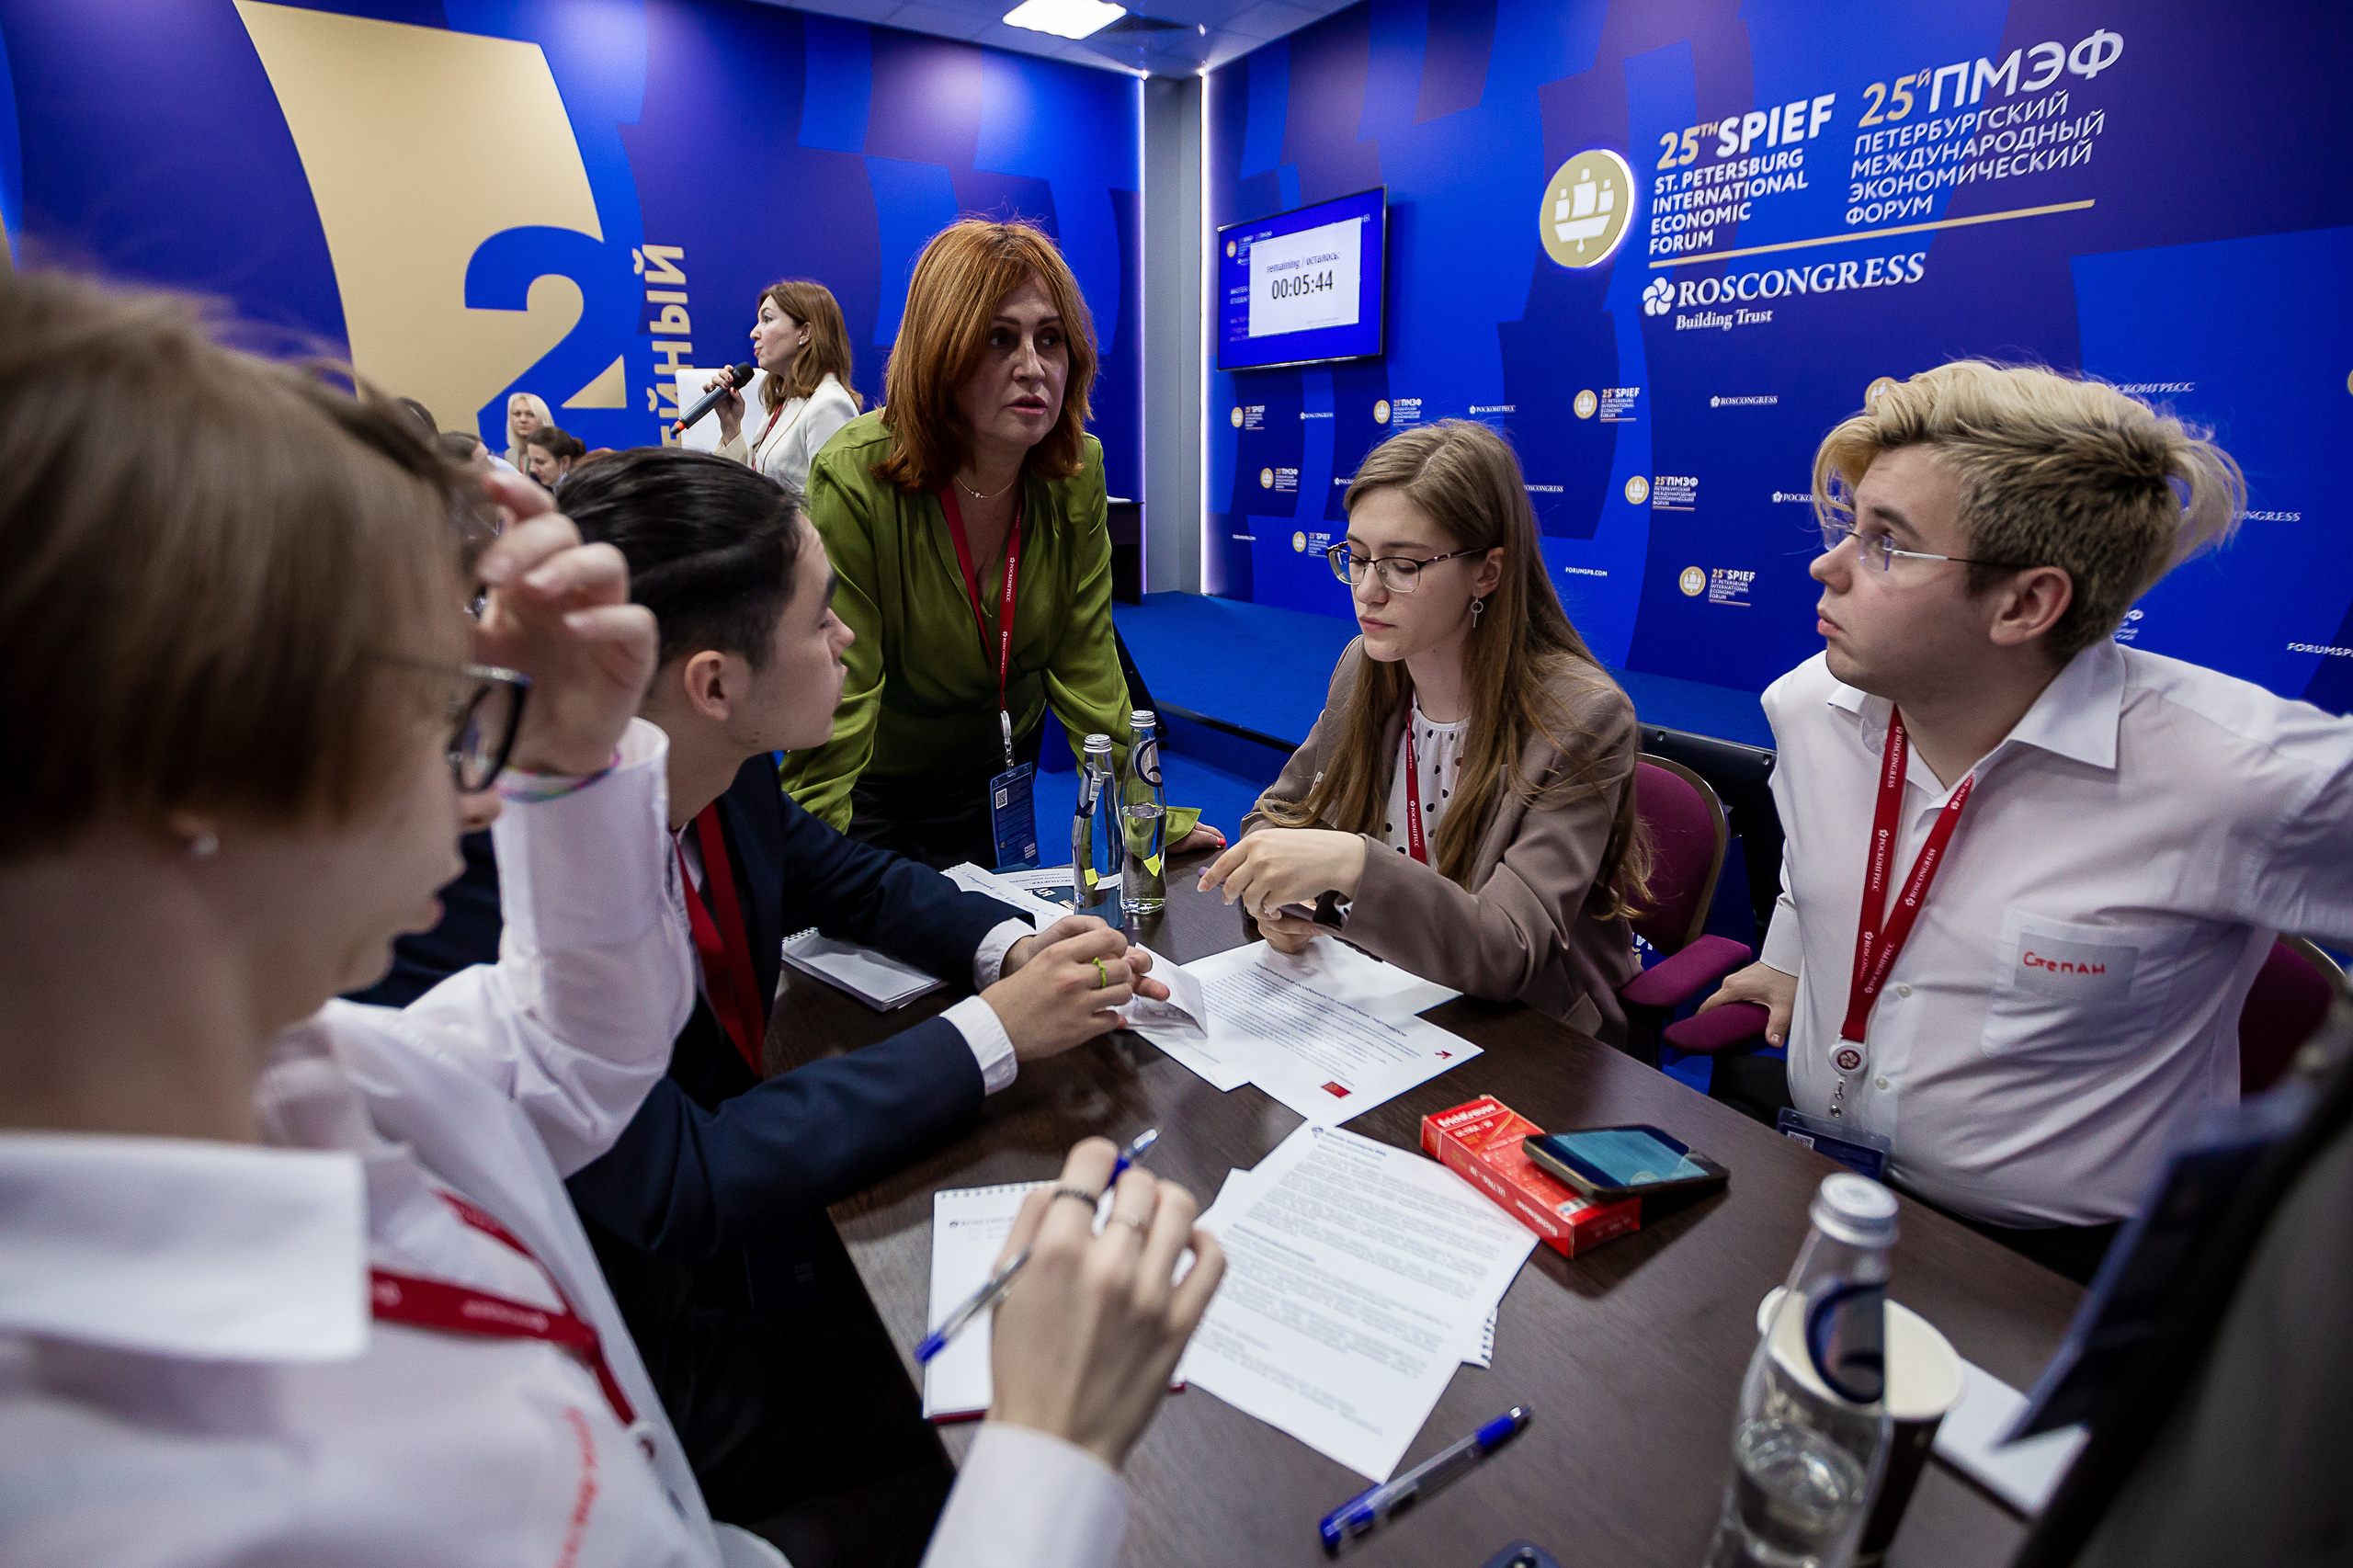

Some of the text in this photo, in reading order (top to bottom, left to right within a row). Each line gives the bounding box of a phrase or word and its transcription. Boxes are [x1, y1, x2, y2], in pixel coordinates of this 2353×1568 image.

[1929, 28, 2124, 113] ПМЭФ
[1656, 93, 1836, 170] 25TH SPIEF
[1854, 89, 2069, 156] ПЕТЕРБУРГСКИЙ
[1851, 108, 2106, 180] МЕЖДУНАРОДНЫЙ
[1654, 148, 1804, 195] ST. PETERSBURG
[1847, 138, 2093, 203] ЭКОНОМИЧЕСКИЙ
[1652, 170, 1809, 215] INTERNATIONAL
[1846, 195, 1934, 225] ФОРУМ
[1650, 201, 1752, 236] ECONOMIC
[1649, 229, 1714, 256] FORUM
[1272, 269, 1333, 300] 00:05:44
[1677, 252, 1926, 308] ROSCONGRESS
[1676, 309, 1773, 331] Building Trust
[1401, 398, 1422, 406] ПМЭФ
[1616, 387, 1640, 398] SPIEF
[1721, 395, 1778, 405] ROSCONGRESS
[1666, 476, 1699, 487] ПМЭФ
[1565, 566, 1608, 577] FORUMSPB.COM
[1727, 569, 1756, 583] SPIEF
[1888, 734, 1903, 789] ROSCONGRESS
[1871, 837, 1887, 892] РОСКОНГРЕСС
[1911, 847, 1937, 900] ROSCONGRESS
